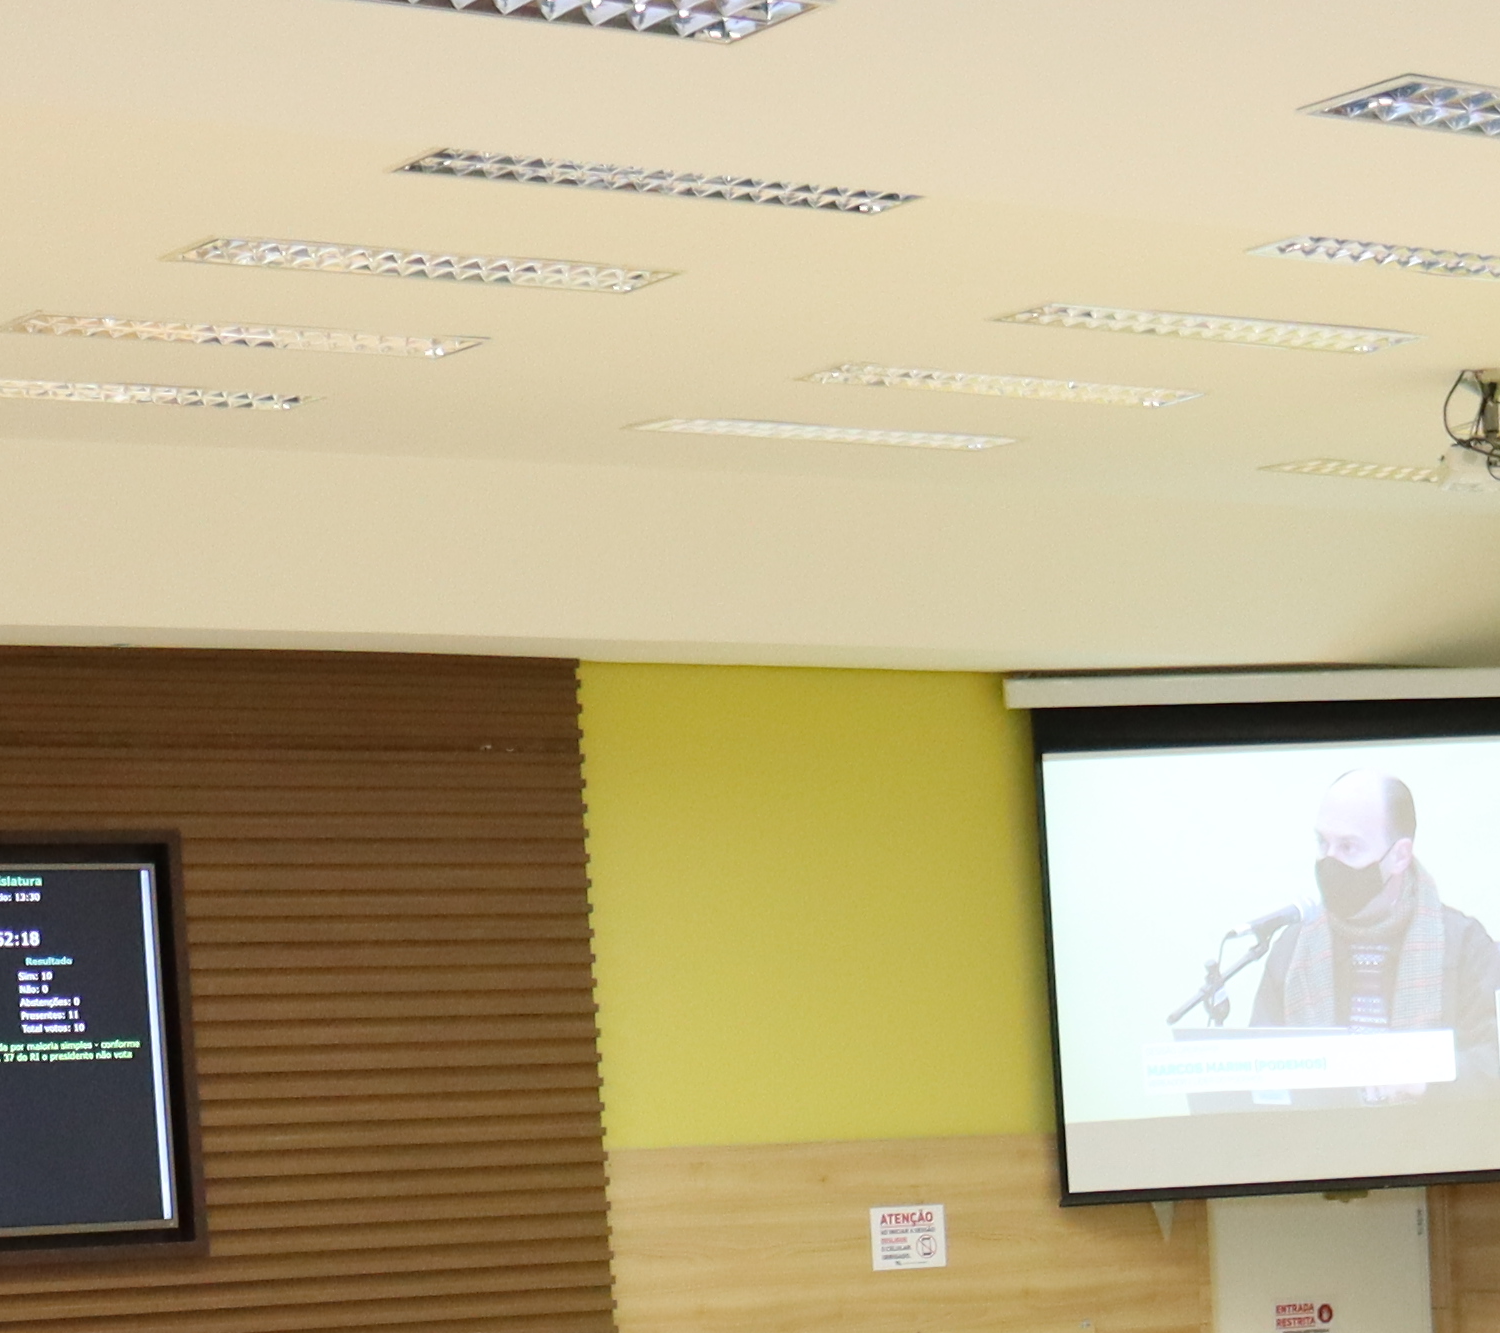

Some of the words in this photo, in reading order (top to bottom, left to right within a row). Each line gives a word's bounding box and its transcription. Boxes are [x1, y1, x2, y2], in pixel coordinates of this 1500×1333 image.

[25, 956, 73, 967] Resultado
[17, 971, 39, 981] Sim:
[41, 971, 53, 980] 10
[18, 984, 40, 994] Não:
[41, 984, 49, 994] 0
[19, 997, 72, 1008] Abstenções:
[73, 997, 81, 1006] 0
[20, 1011, 66, 1021] Presentes:
[68, 1010, 79, 1020] 11
[21, 1024, 43, 1034] Total
[44, 1025, 72, 1033] votos:
[73, 1023, 86, 1033] 10
[10, 1043, 25, 1053] por
[26, 1041, 59, 1051] maioria
[60, 1041, 93, 1051] simples
[100, 1039, 141, 1049] conforme
[3, 1053, 15, 1063] 37
[50, 1052, 94, 1062] presidente
[95, 1050, 112, 1060] não
[113, 1051, 133, 1059] vota
[880, 1209, 934, 1227] ATENÇÃO
[1276, 1303, 1314, 1314] ENTRADA
[1276, 1316, 1316, 1327] RESTRITA
